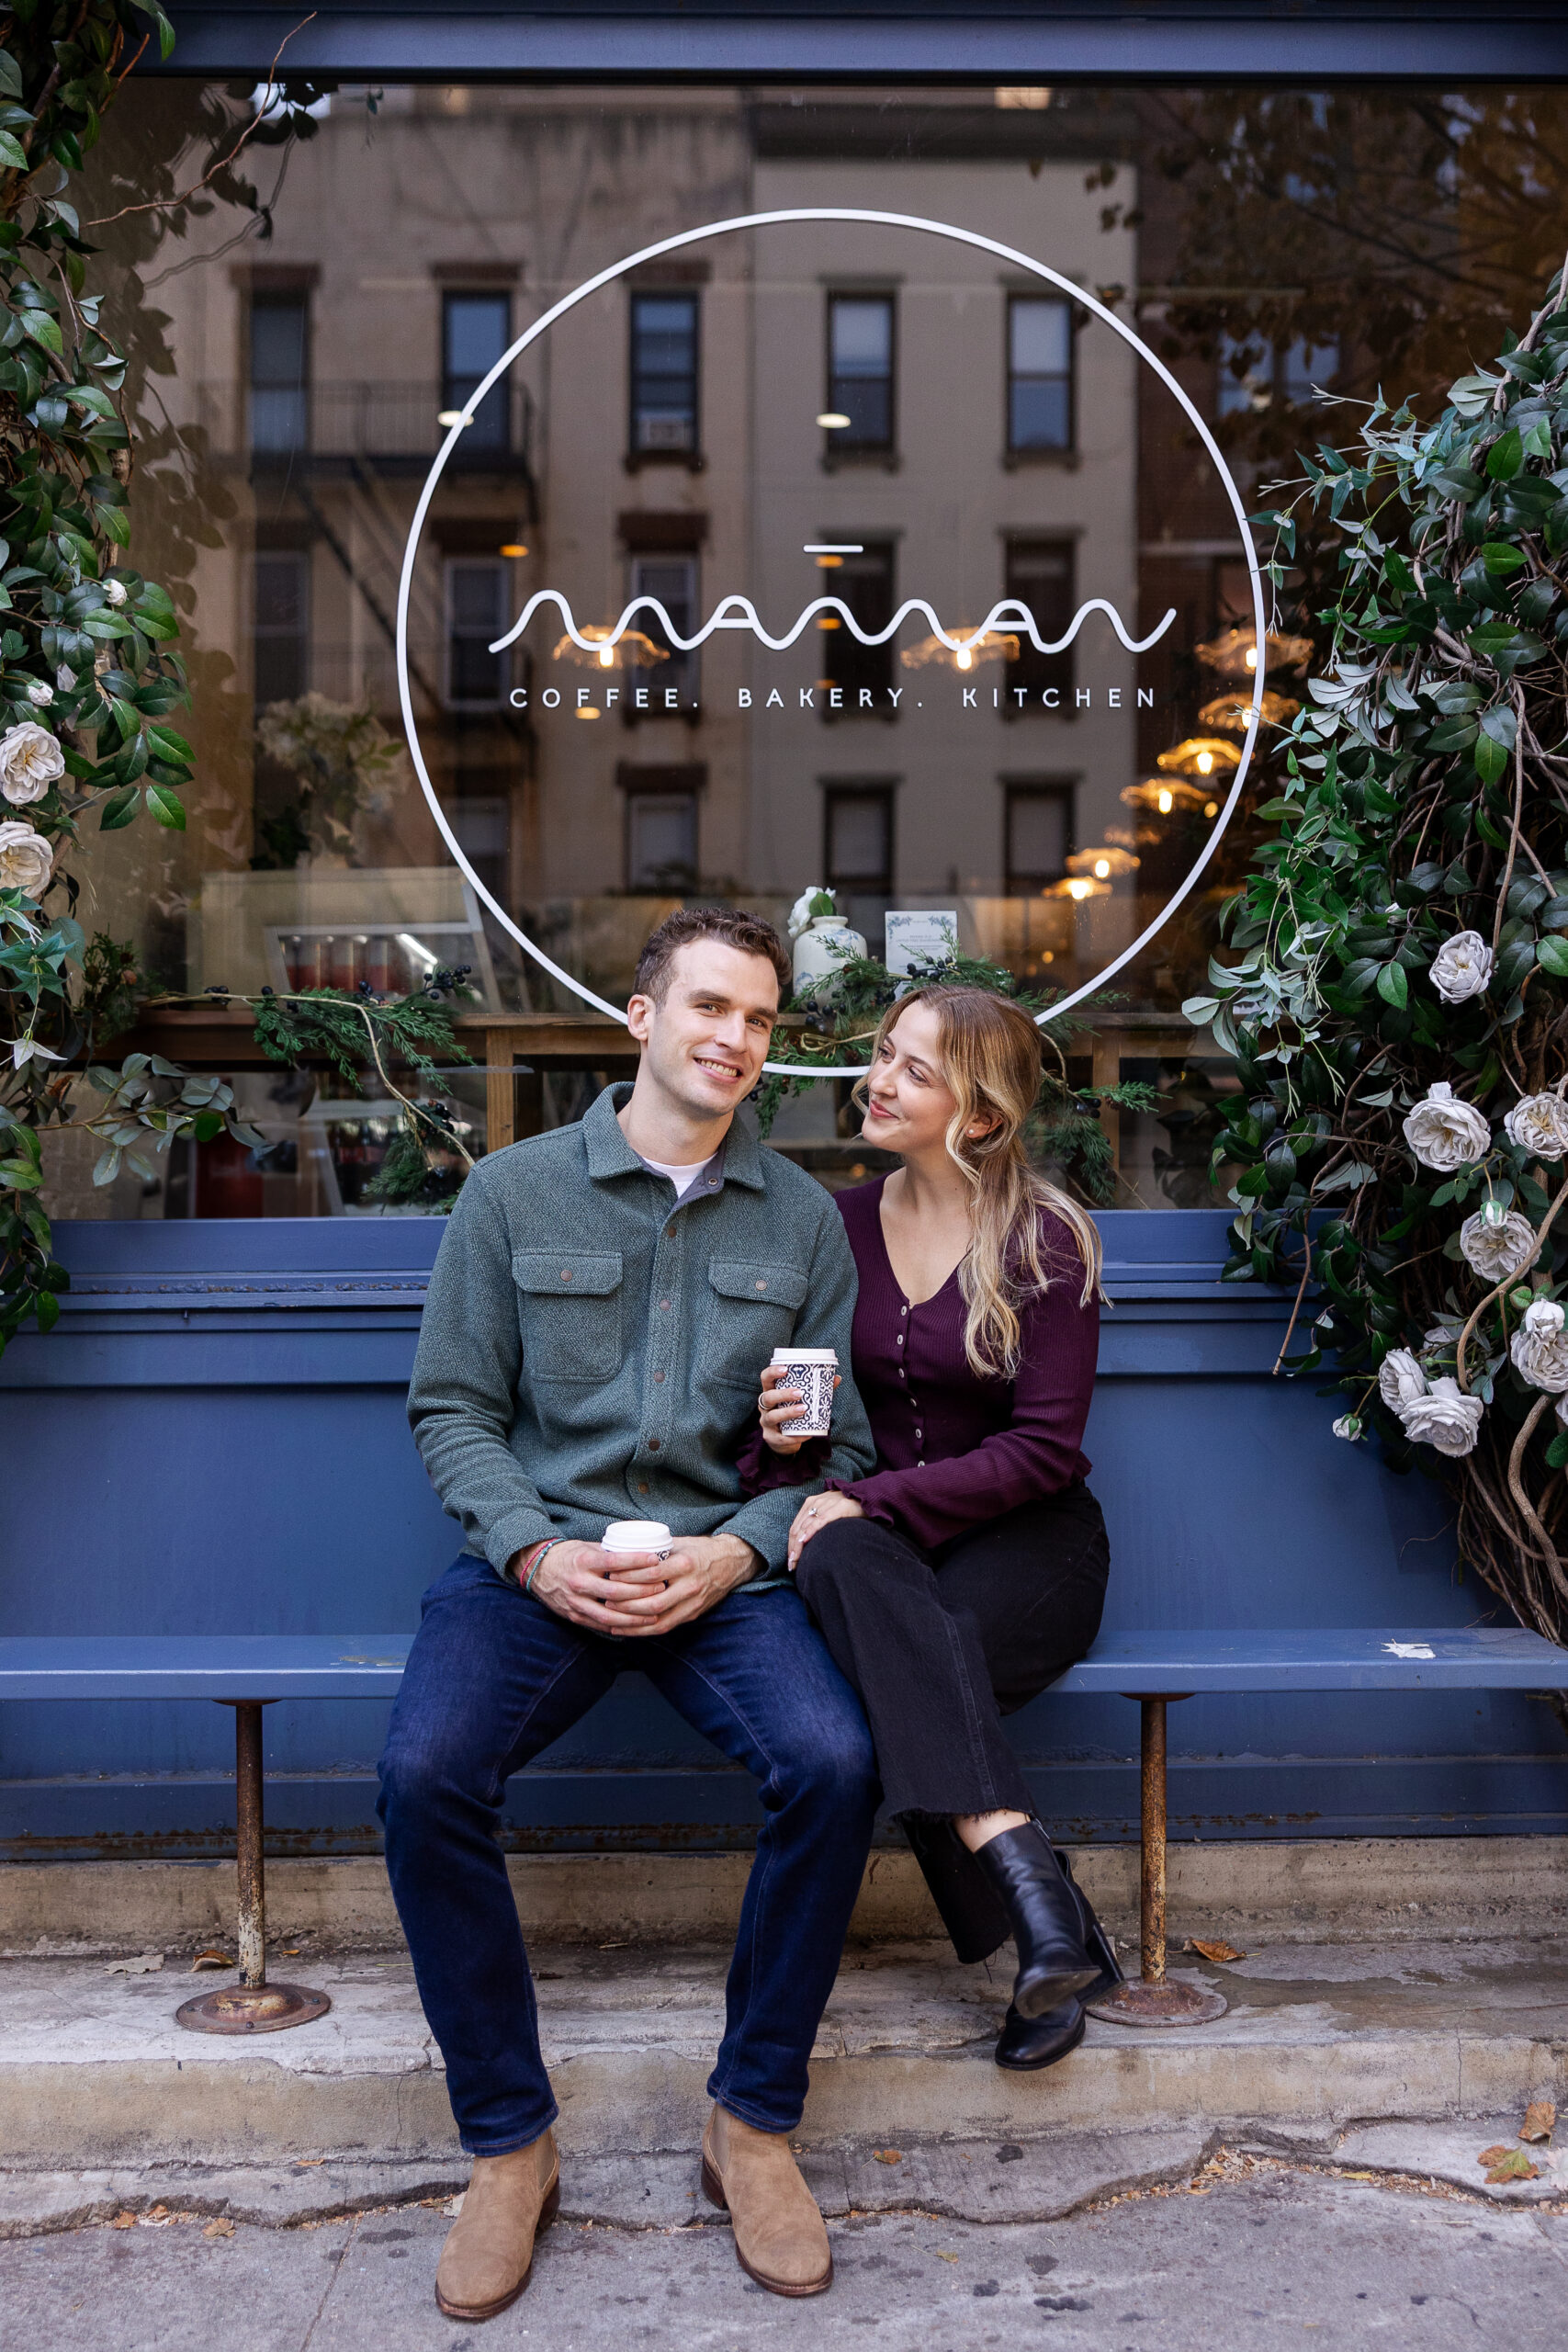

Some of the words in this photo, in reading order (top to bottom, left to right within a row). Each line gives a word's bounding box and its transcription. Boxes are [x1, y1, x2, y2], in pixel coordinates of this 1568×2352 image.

[509, 688, 700, 708] COFFEE.
[738, 687, 924, 708] BAKERY.
[962, 688, 1156, 708] KITCHEN
